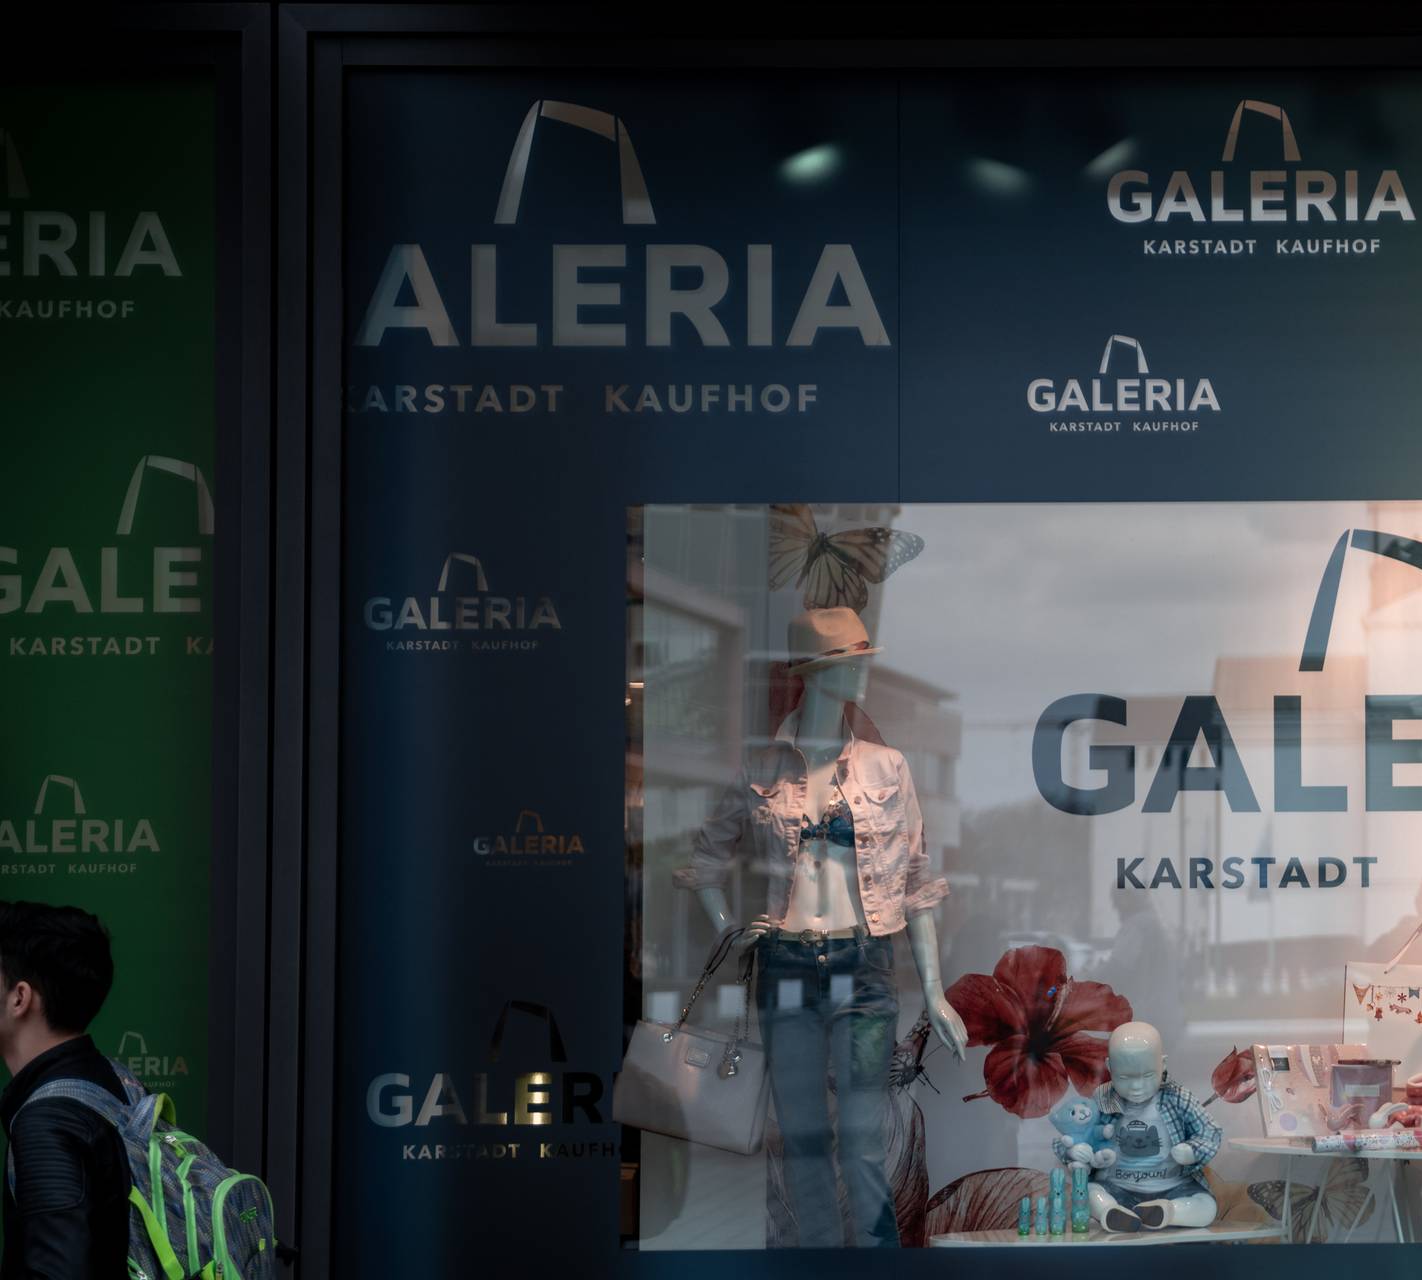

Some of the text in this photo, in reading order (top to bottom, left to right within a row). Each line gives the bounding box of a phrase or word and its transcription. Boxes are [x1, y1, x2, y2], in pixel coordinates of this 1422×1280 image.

[1107, 169, 1416, 224] GALERIA
[0, 210, 183, 277] RIA
[1143, 238, 1380, 255] KARSTADT KAUFHOF
[352, 244, 892, 346] ALERIA
[605, 383, 818, 413] KAUFHOF
[1026, 378, 1222, 413] GALERIA
[1049, 420, 1200, 433] KARSTADT KAUFHOF
[363, 597, 562, 631] GALERIA
[9, 636, 160, 656] KARSTADT
[385, 640, 539, 651] KARSTADT KAUFHOF
[473, 834, 585, 856] GALERIA
[68, 863, 137, 874] KAUFHOF
[1116, 856, 1378, 889] KARSTADT
[112, 1055, 190, 1077] ERIA
[402, 1142, 623, 1161] KARSTADT KAUFH
